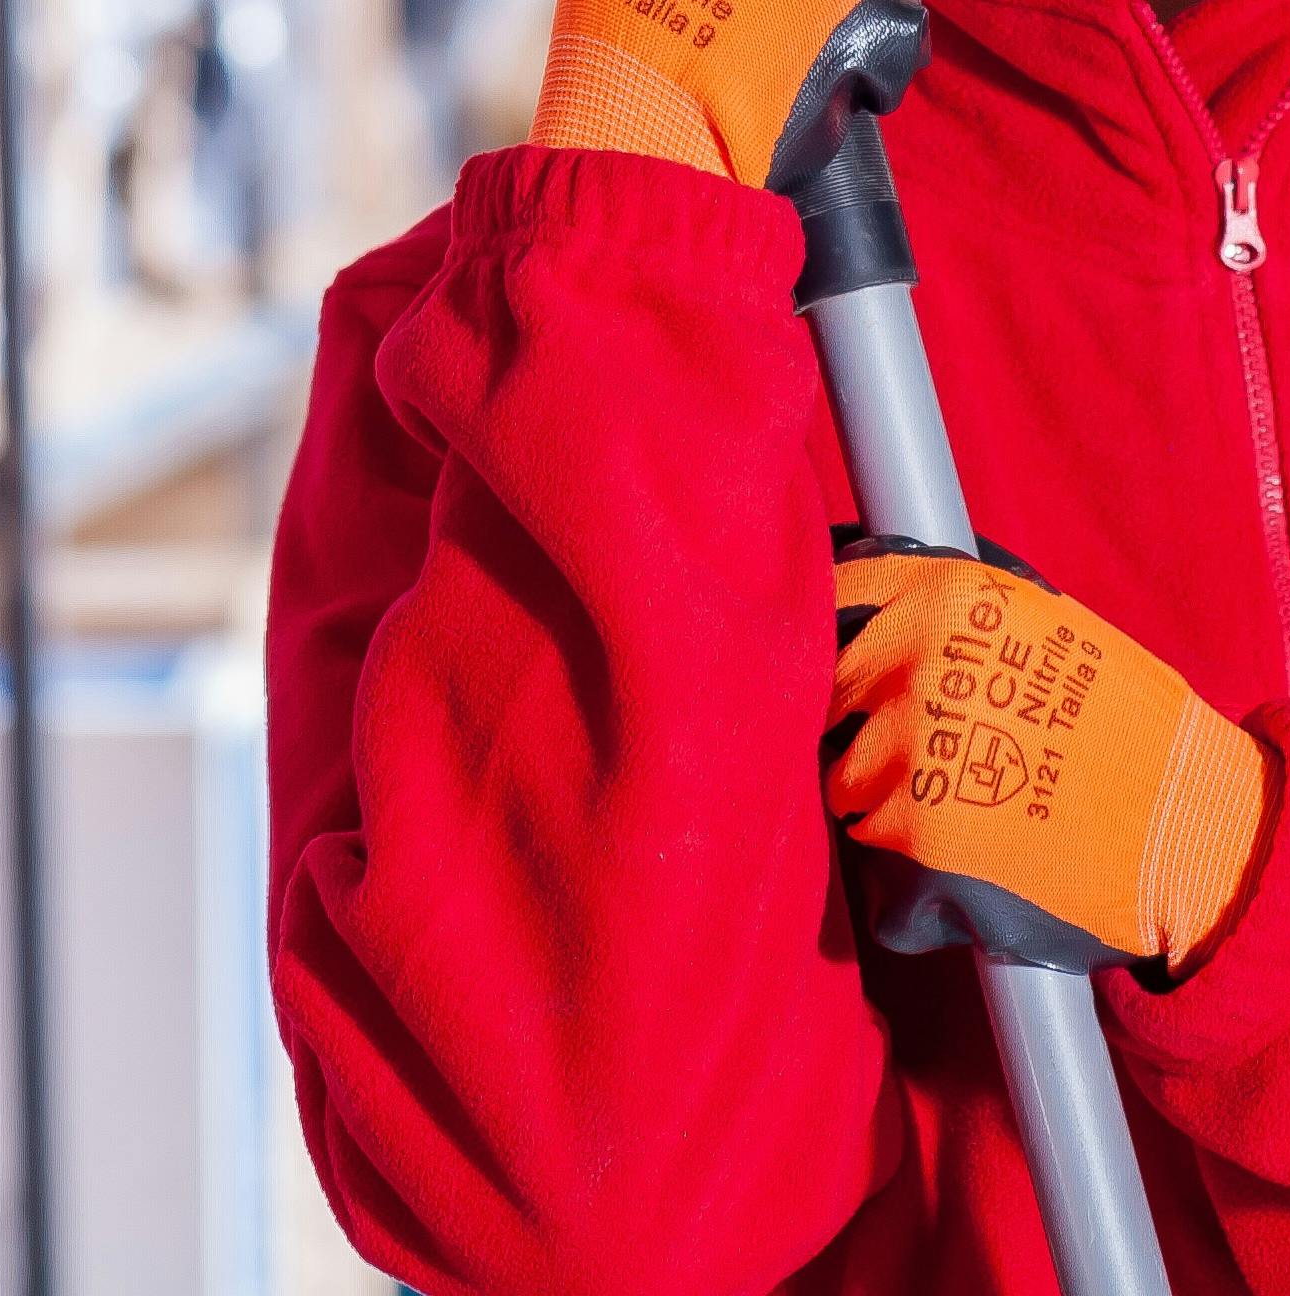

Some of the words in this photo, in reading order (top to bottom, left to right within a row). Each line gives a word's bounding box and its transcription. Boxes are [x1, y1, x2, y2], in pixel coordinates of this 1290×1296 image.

[693, 23, 716, 49] 9
[911, 571, 1016, 807] Safeflex
[985, 634, 1033, 710] CE
[1016, 624, 1076, 726] Nitrile
[1026, 746, 1064, 821] 3121
[1047, 662, 1098, 731] Talla
[1080, 639, 1103, 662] 9
